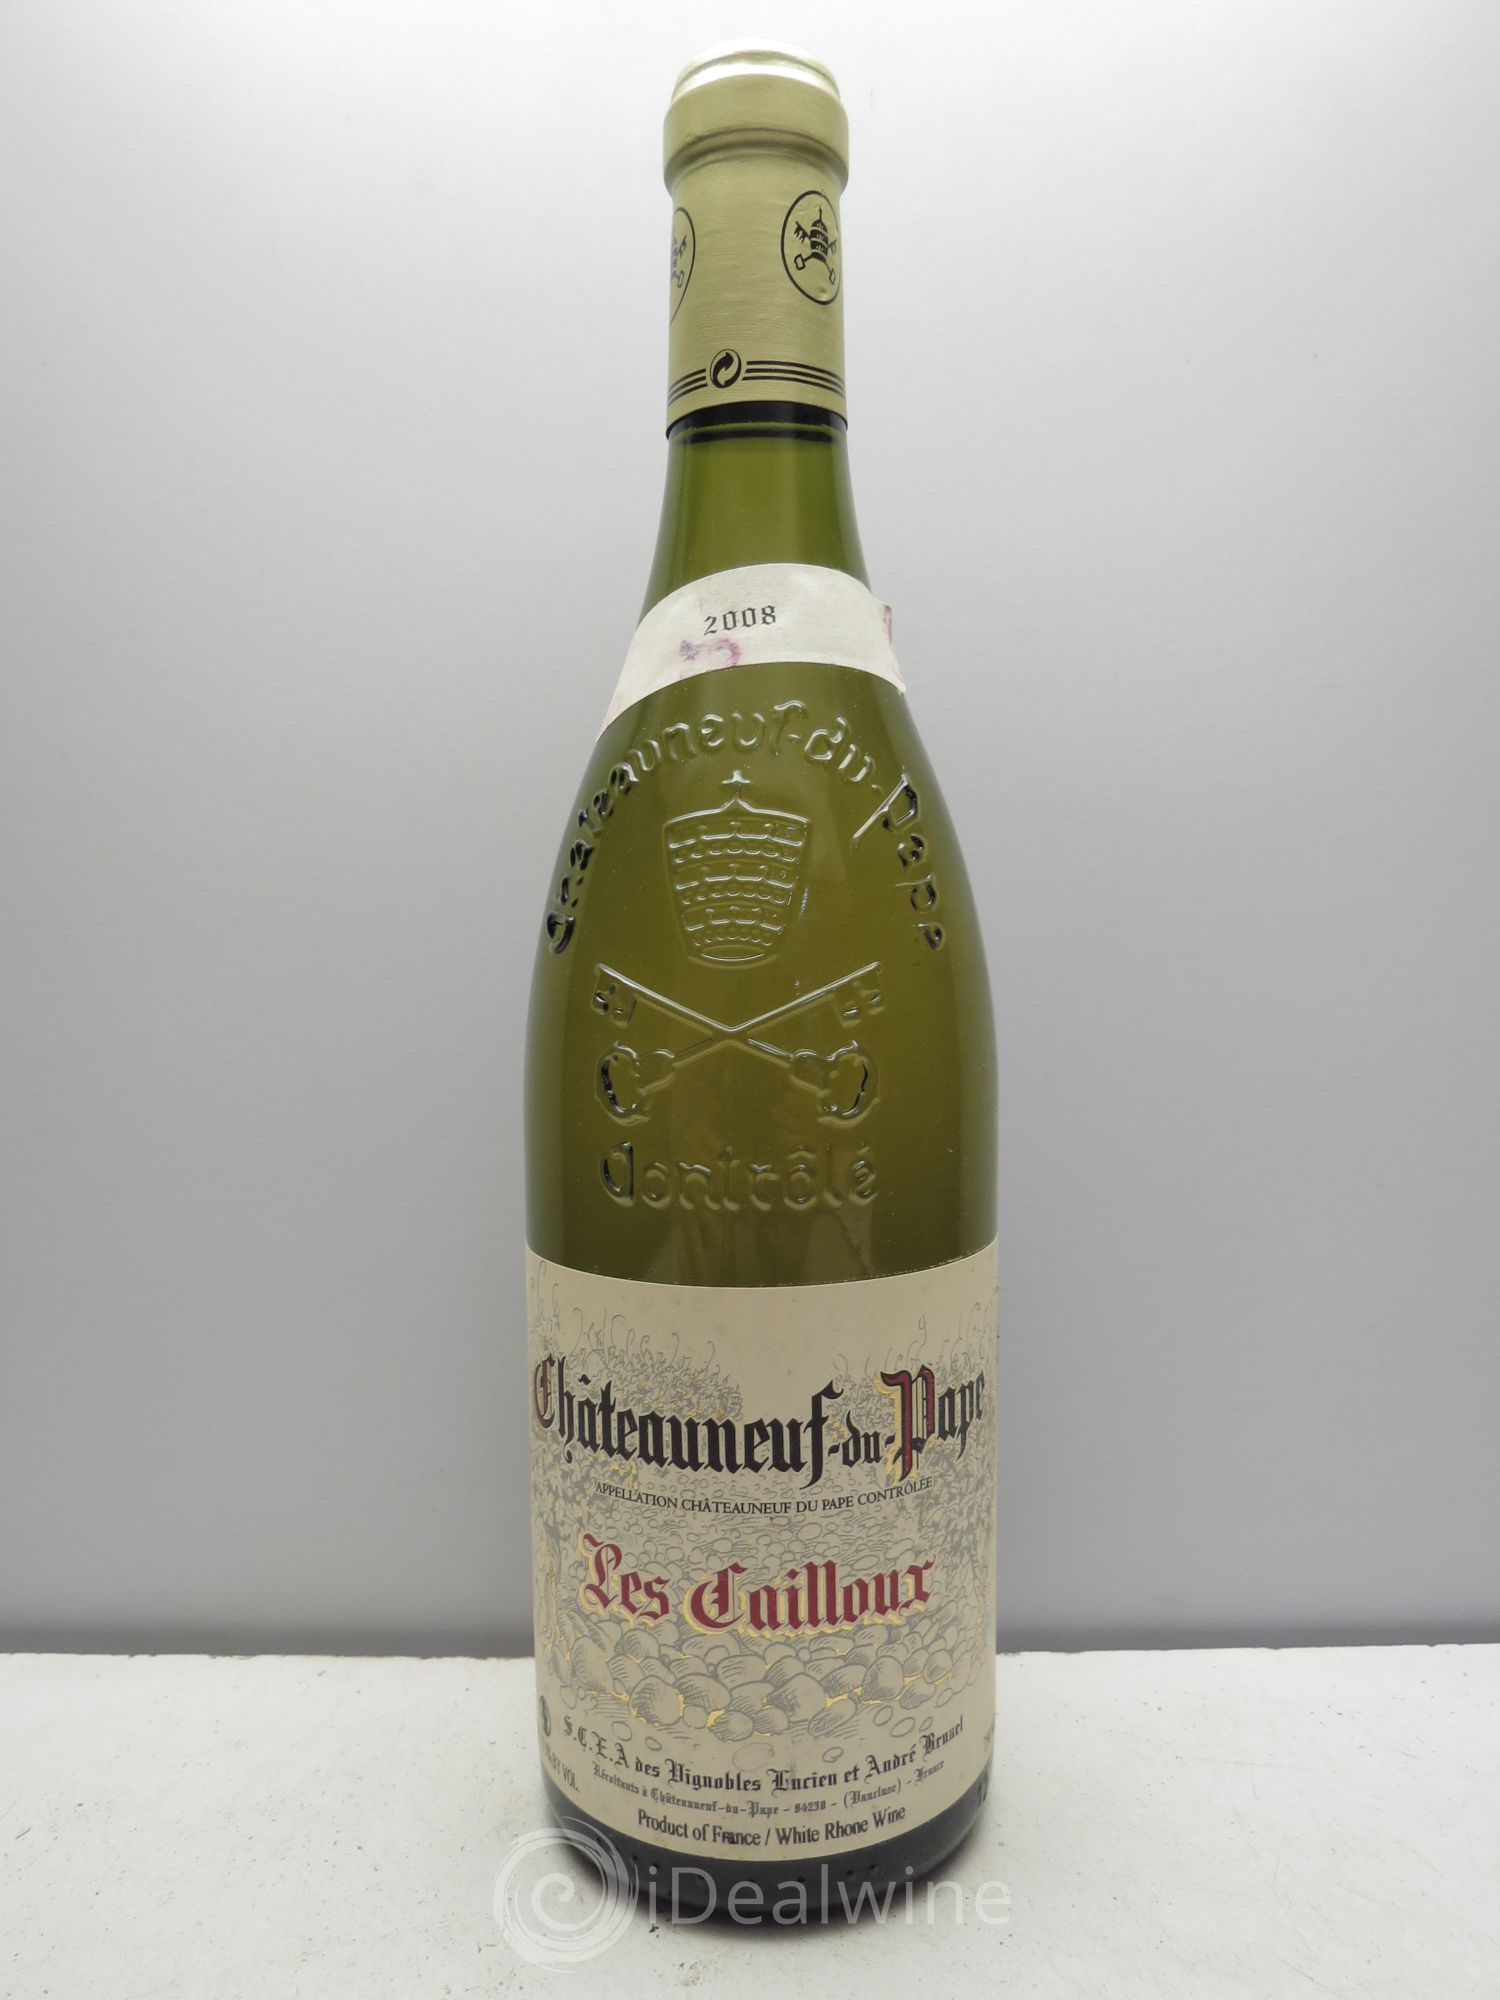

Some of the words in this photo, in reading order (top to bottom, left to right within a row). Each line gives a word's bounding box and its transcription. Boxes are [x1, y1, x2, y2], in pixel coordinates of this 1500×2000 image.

[703, 604, 777, 636] 2008
[533, 1352, 986, 1490] Châteauneuf-du-Pape
[595, 1481, 679, 1509] APPELLATION
[681, 1497, 792, 1515] CHÂTEAUNEUF
[795, 1500, 819, 1513] DU
[822, 1495, 855, 1512] PAPE
[857, 1475, 933, 1506] CONTRÔLÉE
[581, 1532, 671, 1621] Les
[690, 1553, 937, 1631] Cailloux
[634, 1756, 661, 1778] des
[664, 1758, 762, 1792] Vignobles
[765, 1767, 838, 1799] Lucien
[843, 1763, 861, 1783] et
[863, 1743, 917, 1785] André
[918, 1713, 964, 1763] Brunel
[637, 1807, 689, 1839] Product
[692, 1823, 710, 1842] of
[712, 1825, 762, 1847] France
[776, 1823, 820, 1846] White
[824, 1818, 869, 1842] Rhone
[871, 1805, 906, 1830] Wine
[794, 1799, 827, 1814] 84230
